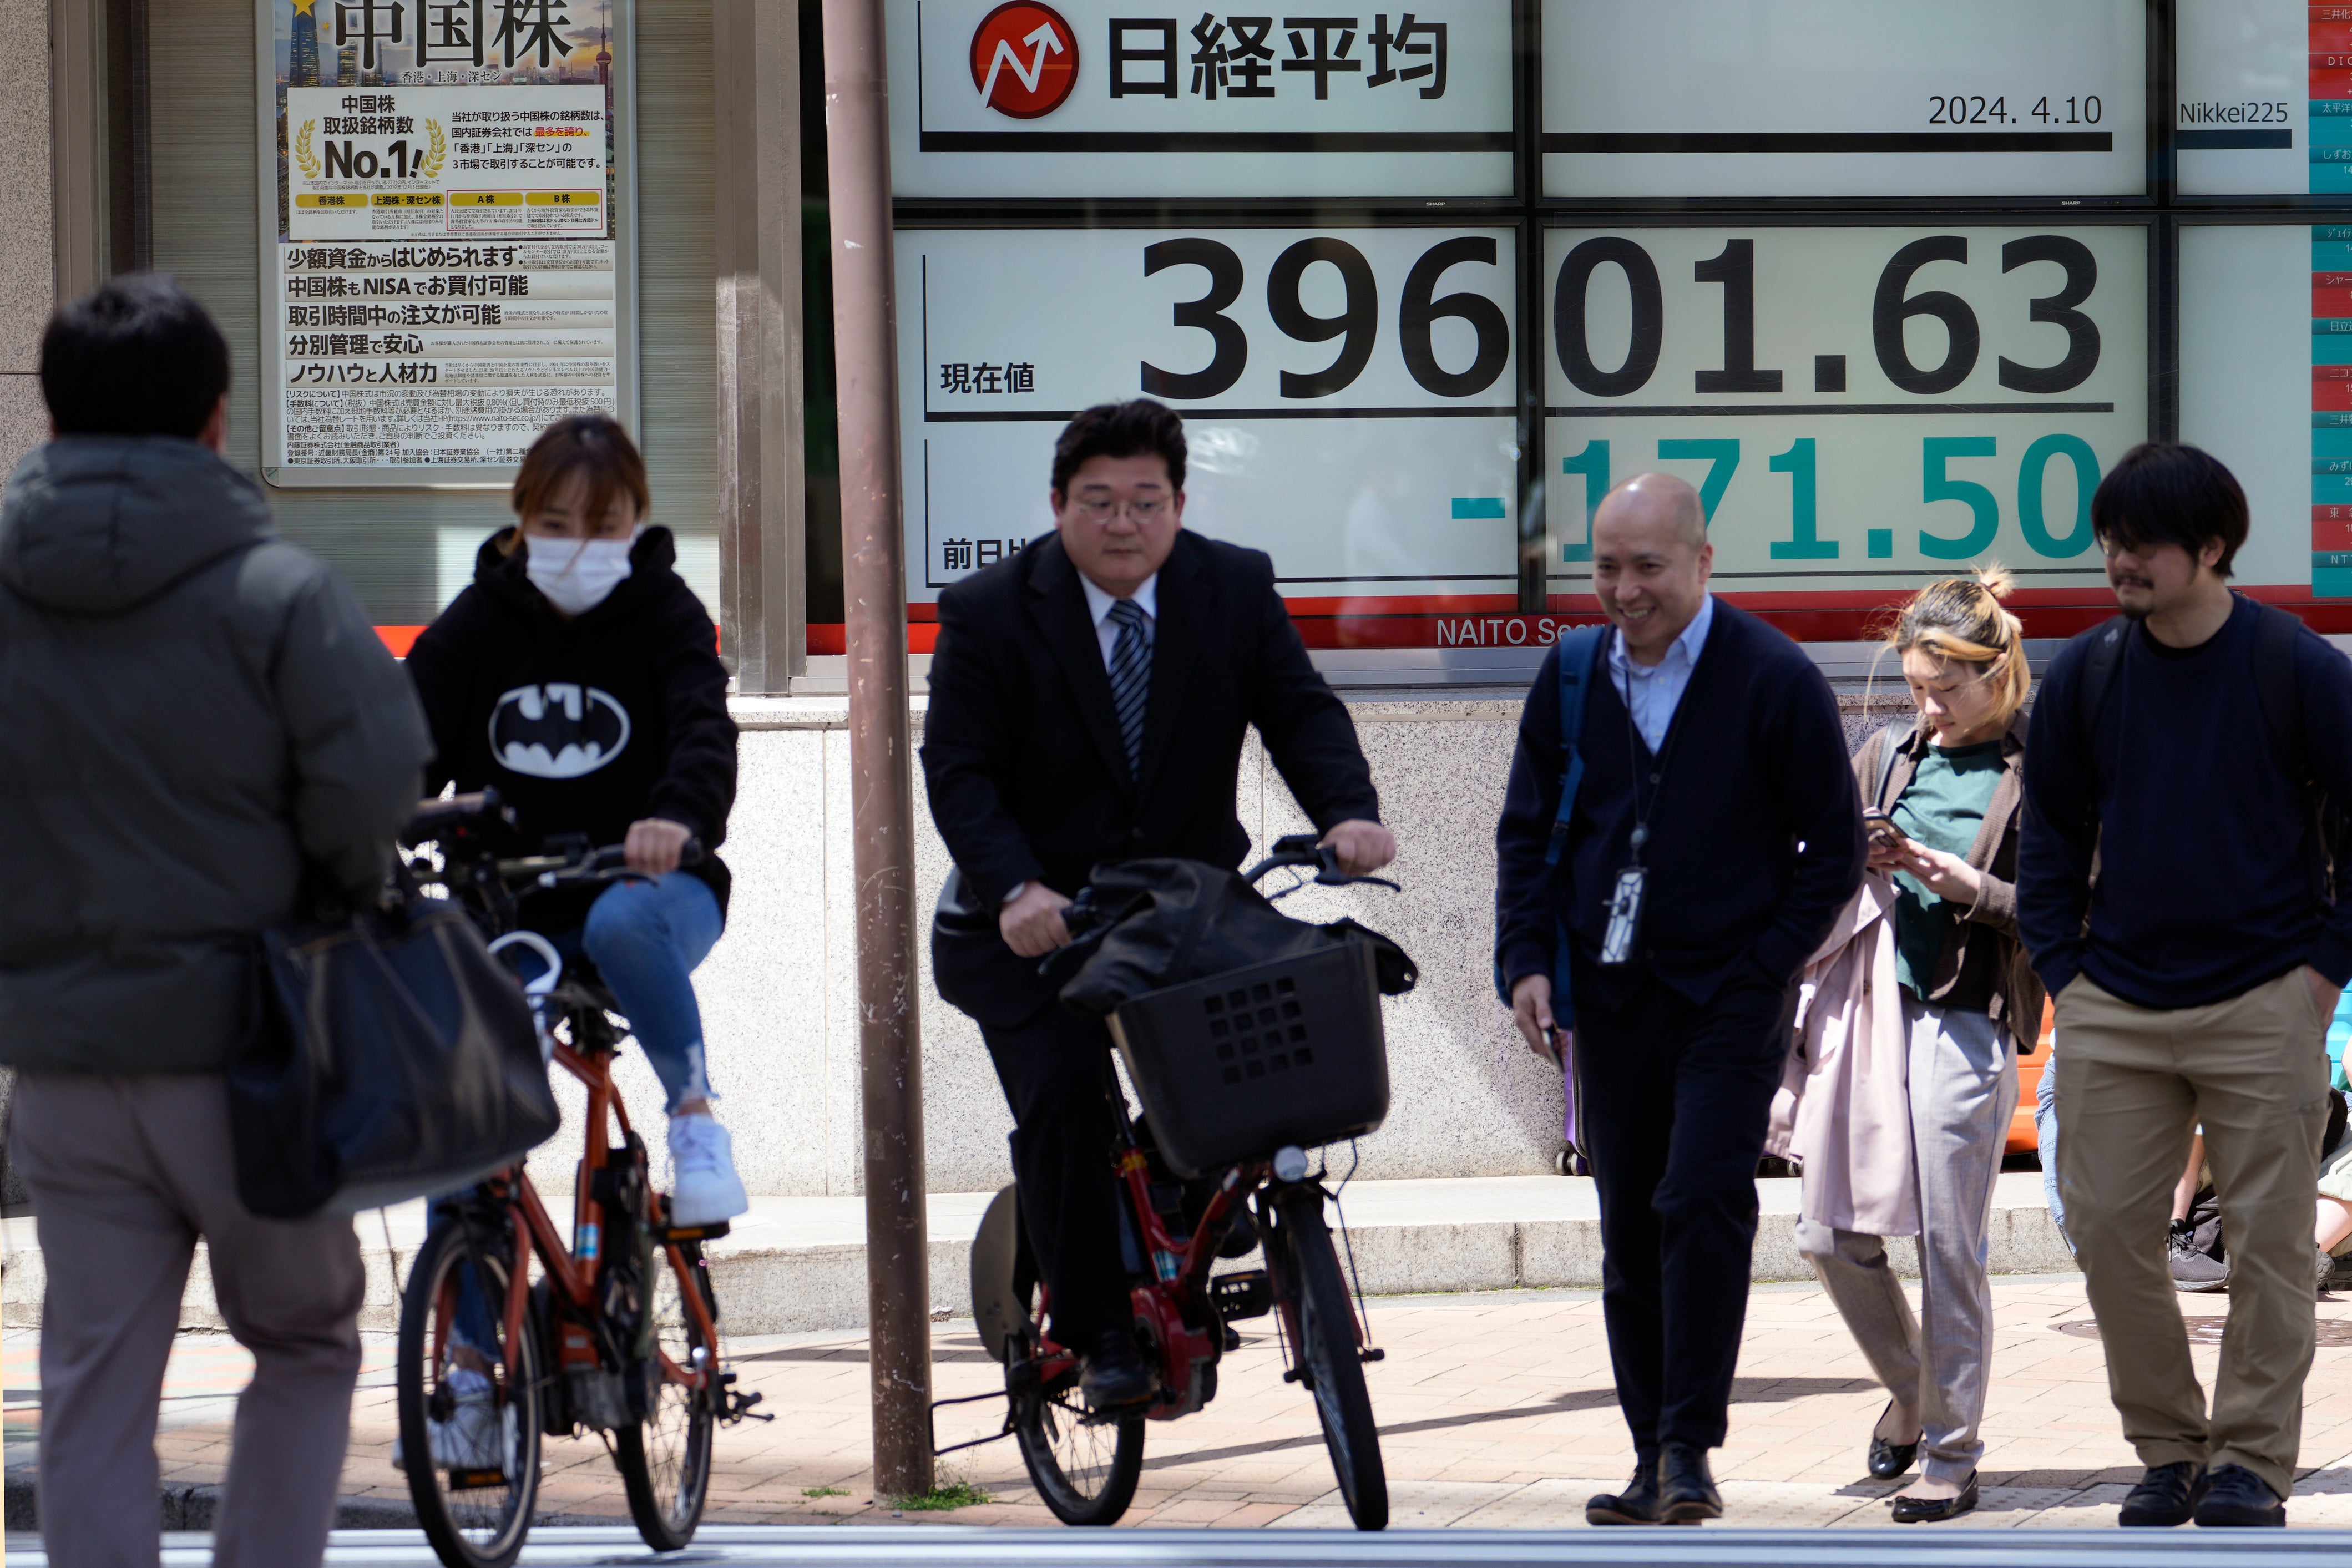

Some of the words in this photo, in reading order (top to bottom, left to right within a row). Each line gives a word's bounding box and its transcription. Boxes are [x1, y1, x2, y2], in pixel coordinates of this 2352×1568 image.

[2321, 9, 2352, 20] 三井化
[335, 0, 574, 70] 中国株
[1110, 12, 1448, 100] 日経平均
[401, 70, 502, 83] 香港・上海・深セン
[342, 94, 396, 114] 中国株
[2181, 102, 2288, 123] Nikkei225
[2322, 103, 2352, 113] 太平洋
[323, 115, 414, 135] 取扱銘柄数
[452, 111, 605, 122] 当社が取り扱う中国株の銘柄数は、
[325, 140, 423, 179] No.1!
[2324, 150, 2352, 159] しずお
[318, 195, 345, 205] 香港株
[374, 195, 442, 205] 上海株・深セン株
[287, 246, 518, 270] 少額資金からはじめられます
[288, 305, 501, 326] 取引時間中の注文が可能
[2331, 321, 2352, 331] 日立
[288, 334, 423, 355] 分別管理で安心
[290, 362, 438, 384] ノウハウと人材力
[940, 362, 1035, 394] 現在値
[2330, 368, 2352, 378] ニコ
[2330, 461, 2352, 471] みず
[2331, 555, 2352, 564] NT
[1437, 619, 1526, 645] NAITO
